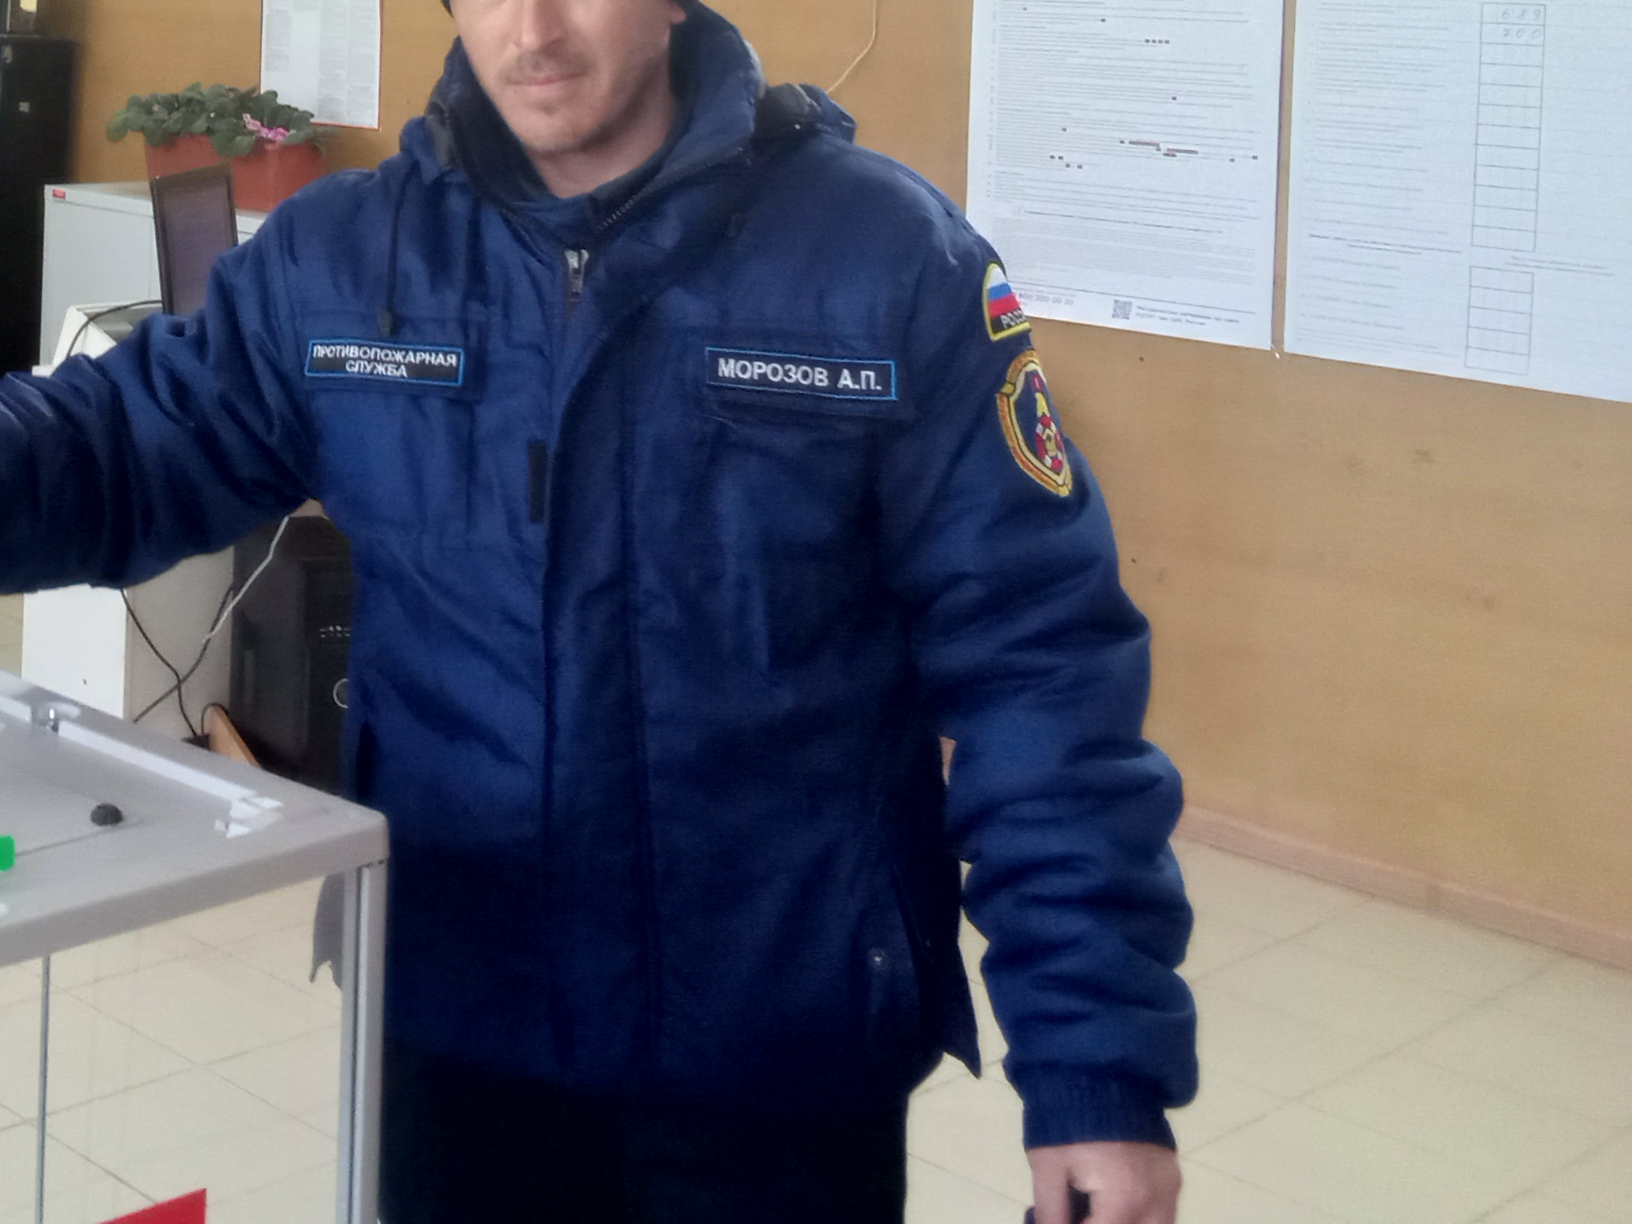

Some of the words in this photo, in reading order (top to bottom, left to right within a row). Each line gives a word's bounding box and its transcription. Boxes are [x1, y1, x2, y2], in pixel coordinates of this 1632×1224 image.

[312, 344, 458, 367] ПРОТИВОПОЖАРНАЯ
[345, 360, 408, 378] СЛУЖБА
[718, 357, 829, 387] МОРОЗОВ
[837, 369, 882, 390] А.П.
